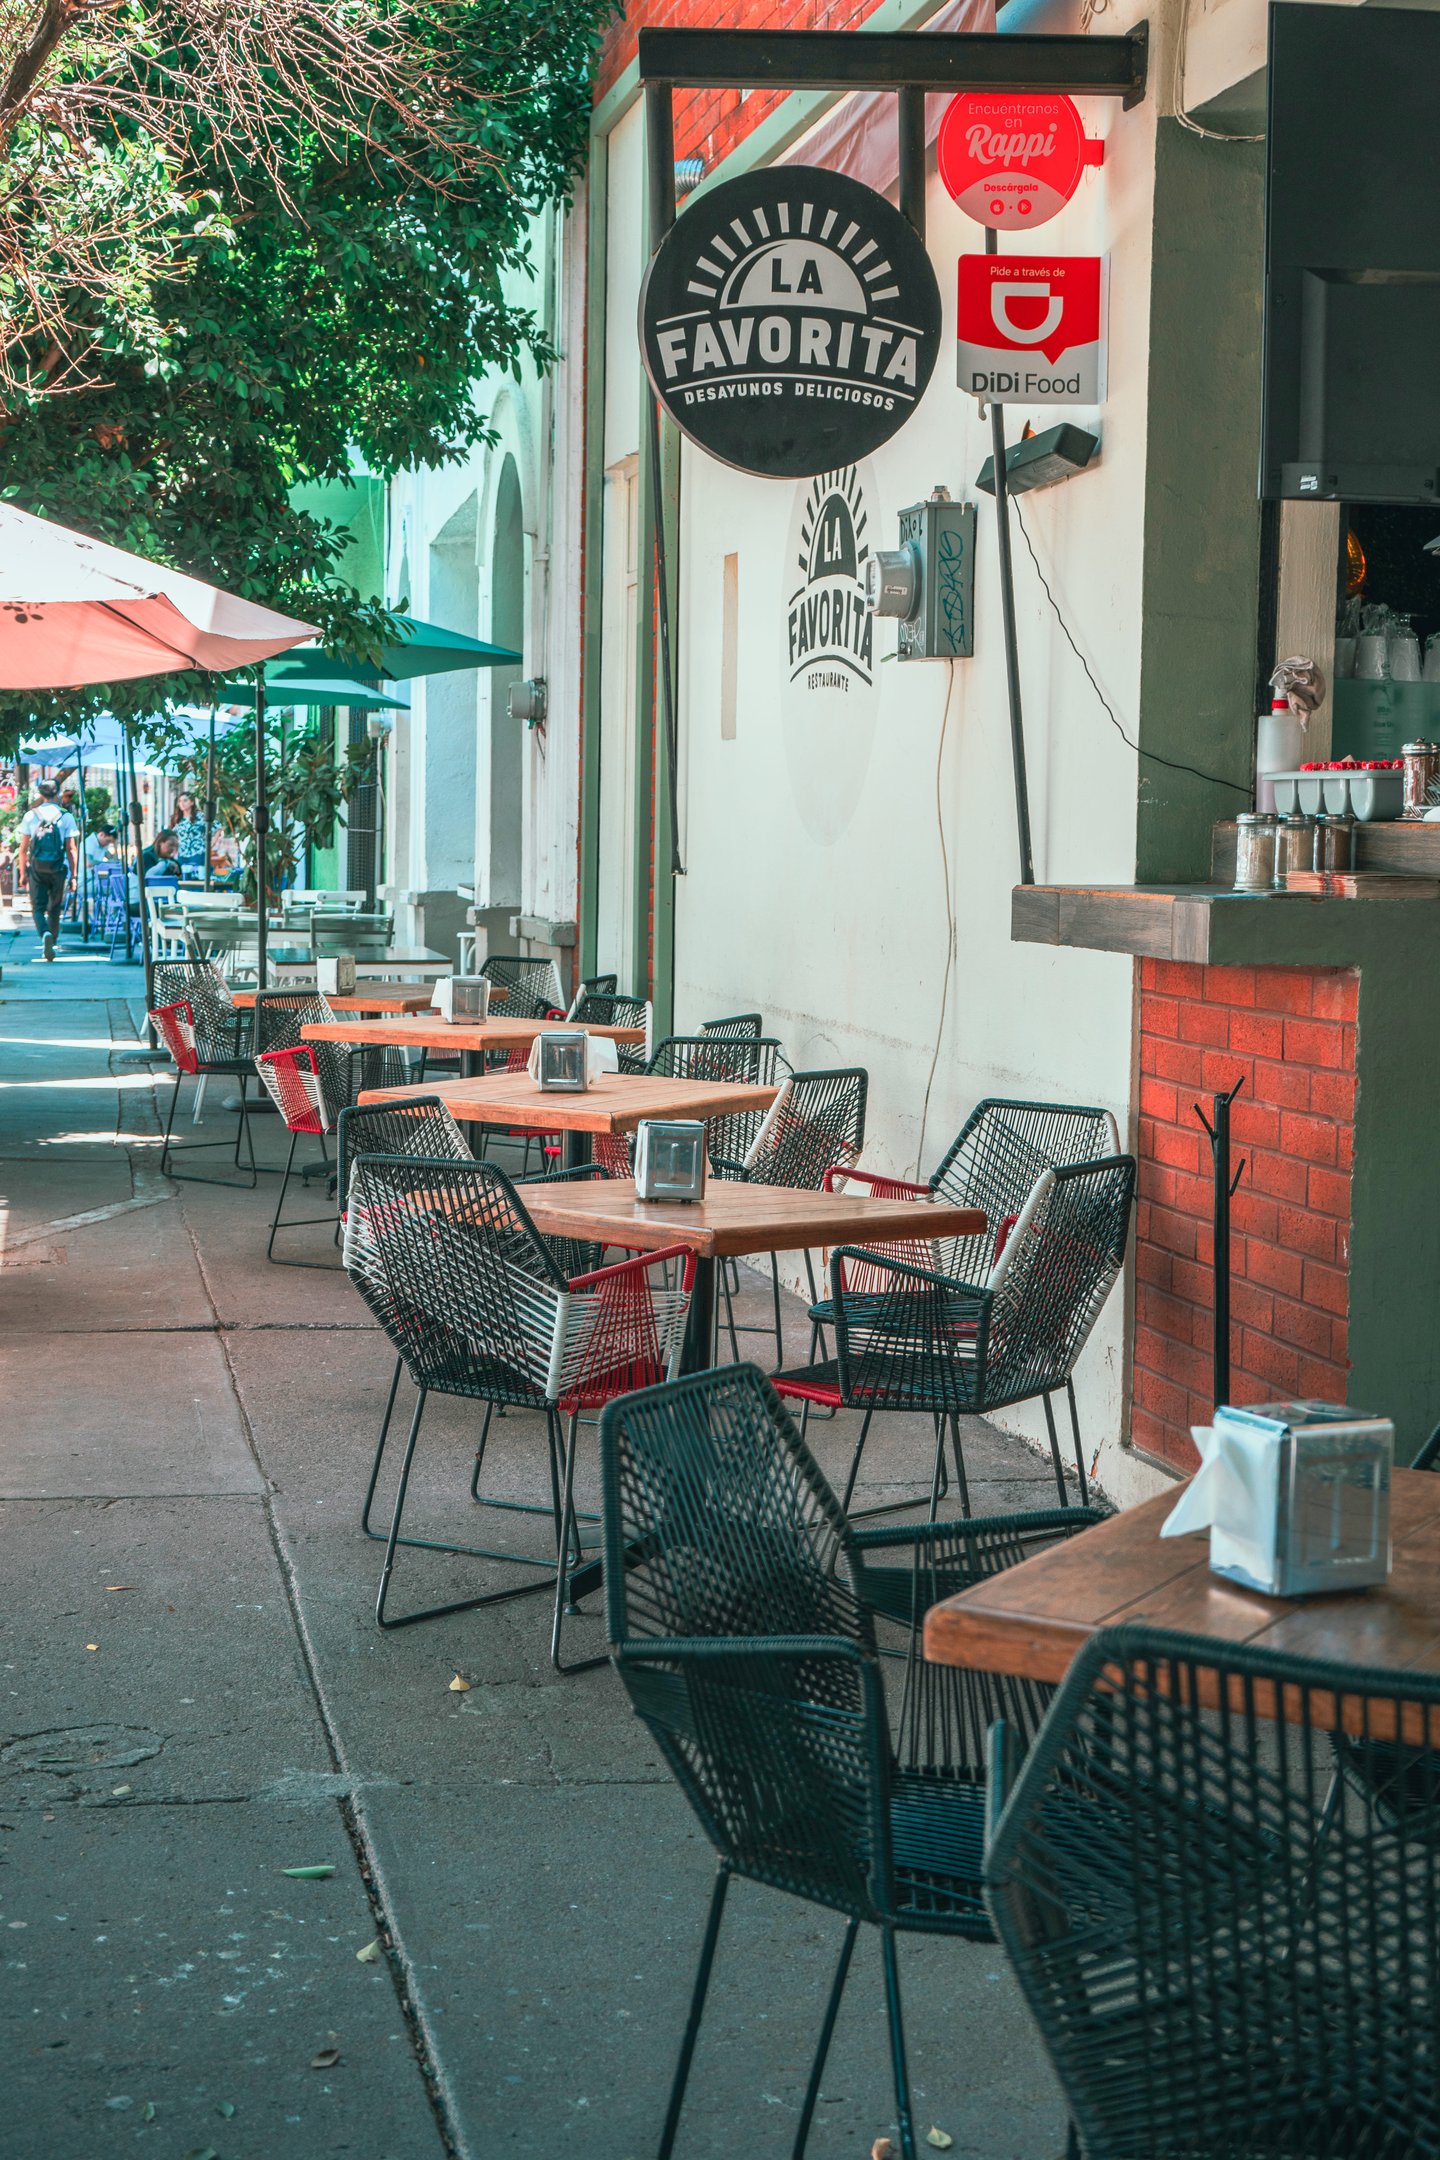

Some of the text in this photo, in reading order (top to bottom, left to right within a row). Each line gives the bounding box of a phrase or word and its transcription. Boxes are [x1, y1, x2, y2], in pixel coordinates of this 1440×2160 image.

[968, 103, 1059, 115] Encuéntranos
[1004, 118, 1023, 128] en
[965, 122, 1058, 167] Rappi
[983, 182, 1039, 194] Descárgala
[770, 257, 824, 295] LA
[990, 266, 1011, 276] Pide
[1022, 267, 1051, 277] través
[1053, 267, 1066, 277] de
[656, 316, 917, 387] FAVORITA
[972, 371, 1081, 394] DiDi Food
[684, 382, 895, 411] DESAYUNOS DELICIOSOS
[823, 517, 843, 563] LA
[788, 588, 873, 672] FAVORITA
[807, 671, 849, 693] RESTAURANTE
